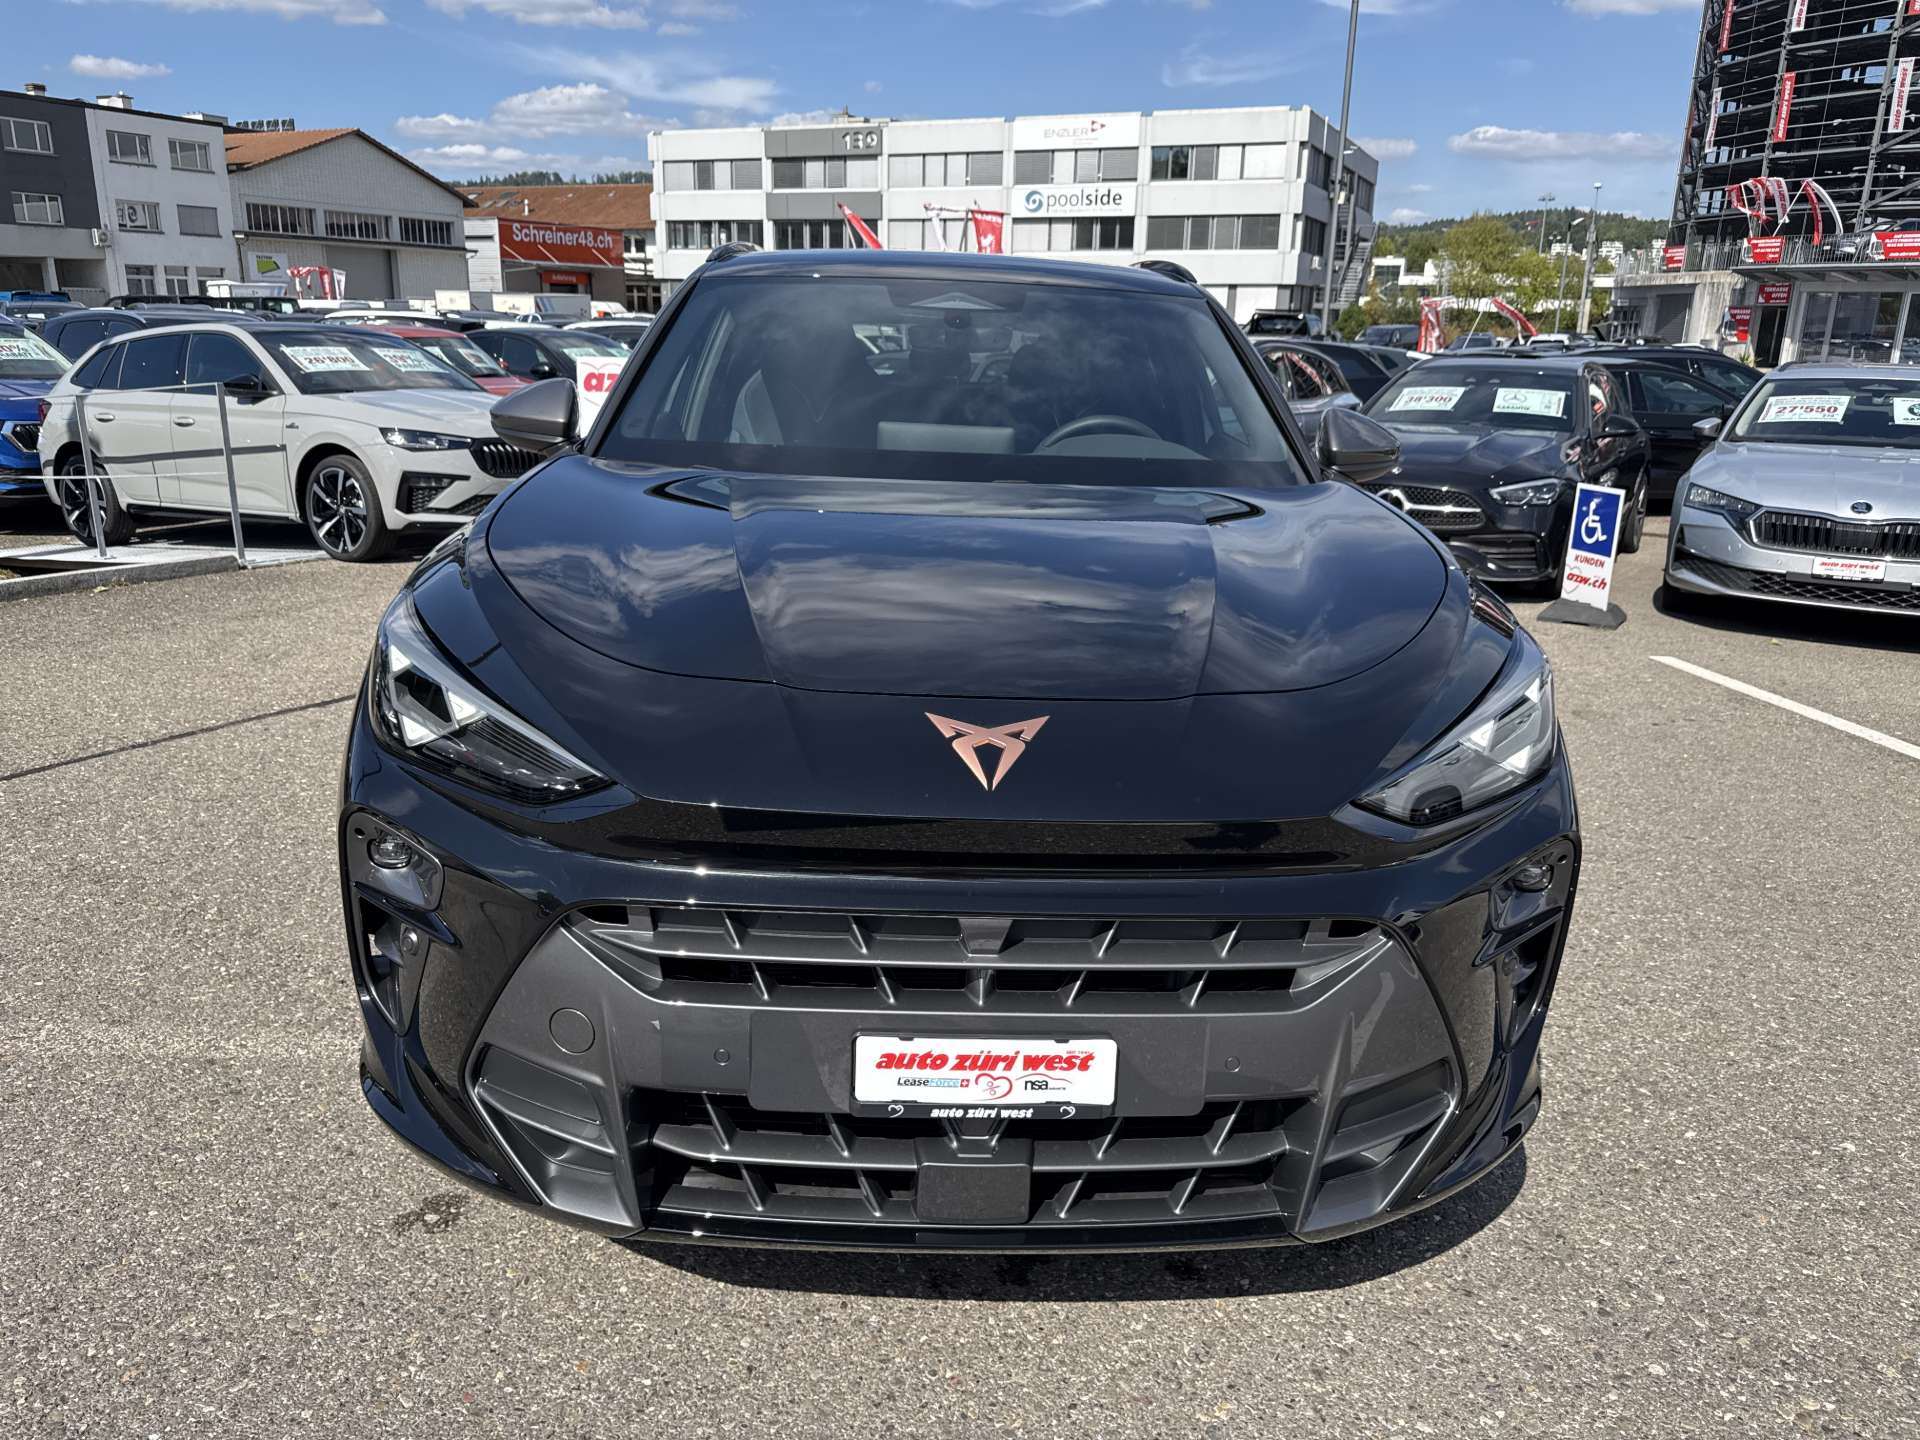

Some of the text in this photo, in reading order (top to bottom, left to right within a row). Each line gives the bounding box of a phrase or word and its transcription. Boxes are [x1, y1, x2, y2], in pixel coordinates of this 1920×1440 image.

[841, 130, 878, 150] 139
[1043, 127, 1089, 139] ENZLER
[1046, 188, 1123, 213] poolside
[512, 223, 613, 249] Schreiner48.ch
[1775, 405, 1839, 414] 27'550
[1574, 554, 1606, 569] KUNDEN
[1566, 572, 1608, 590] azw.ch
[875, 1050, 1096, 1072] auto züri west
[896, 1076, 960, 1088] LeaseForce
[1024, 1079, 1049, 1091] nsa
[930, 1107, 1034, 1119] auto züri west
